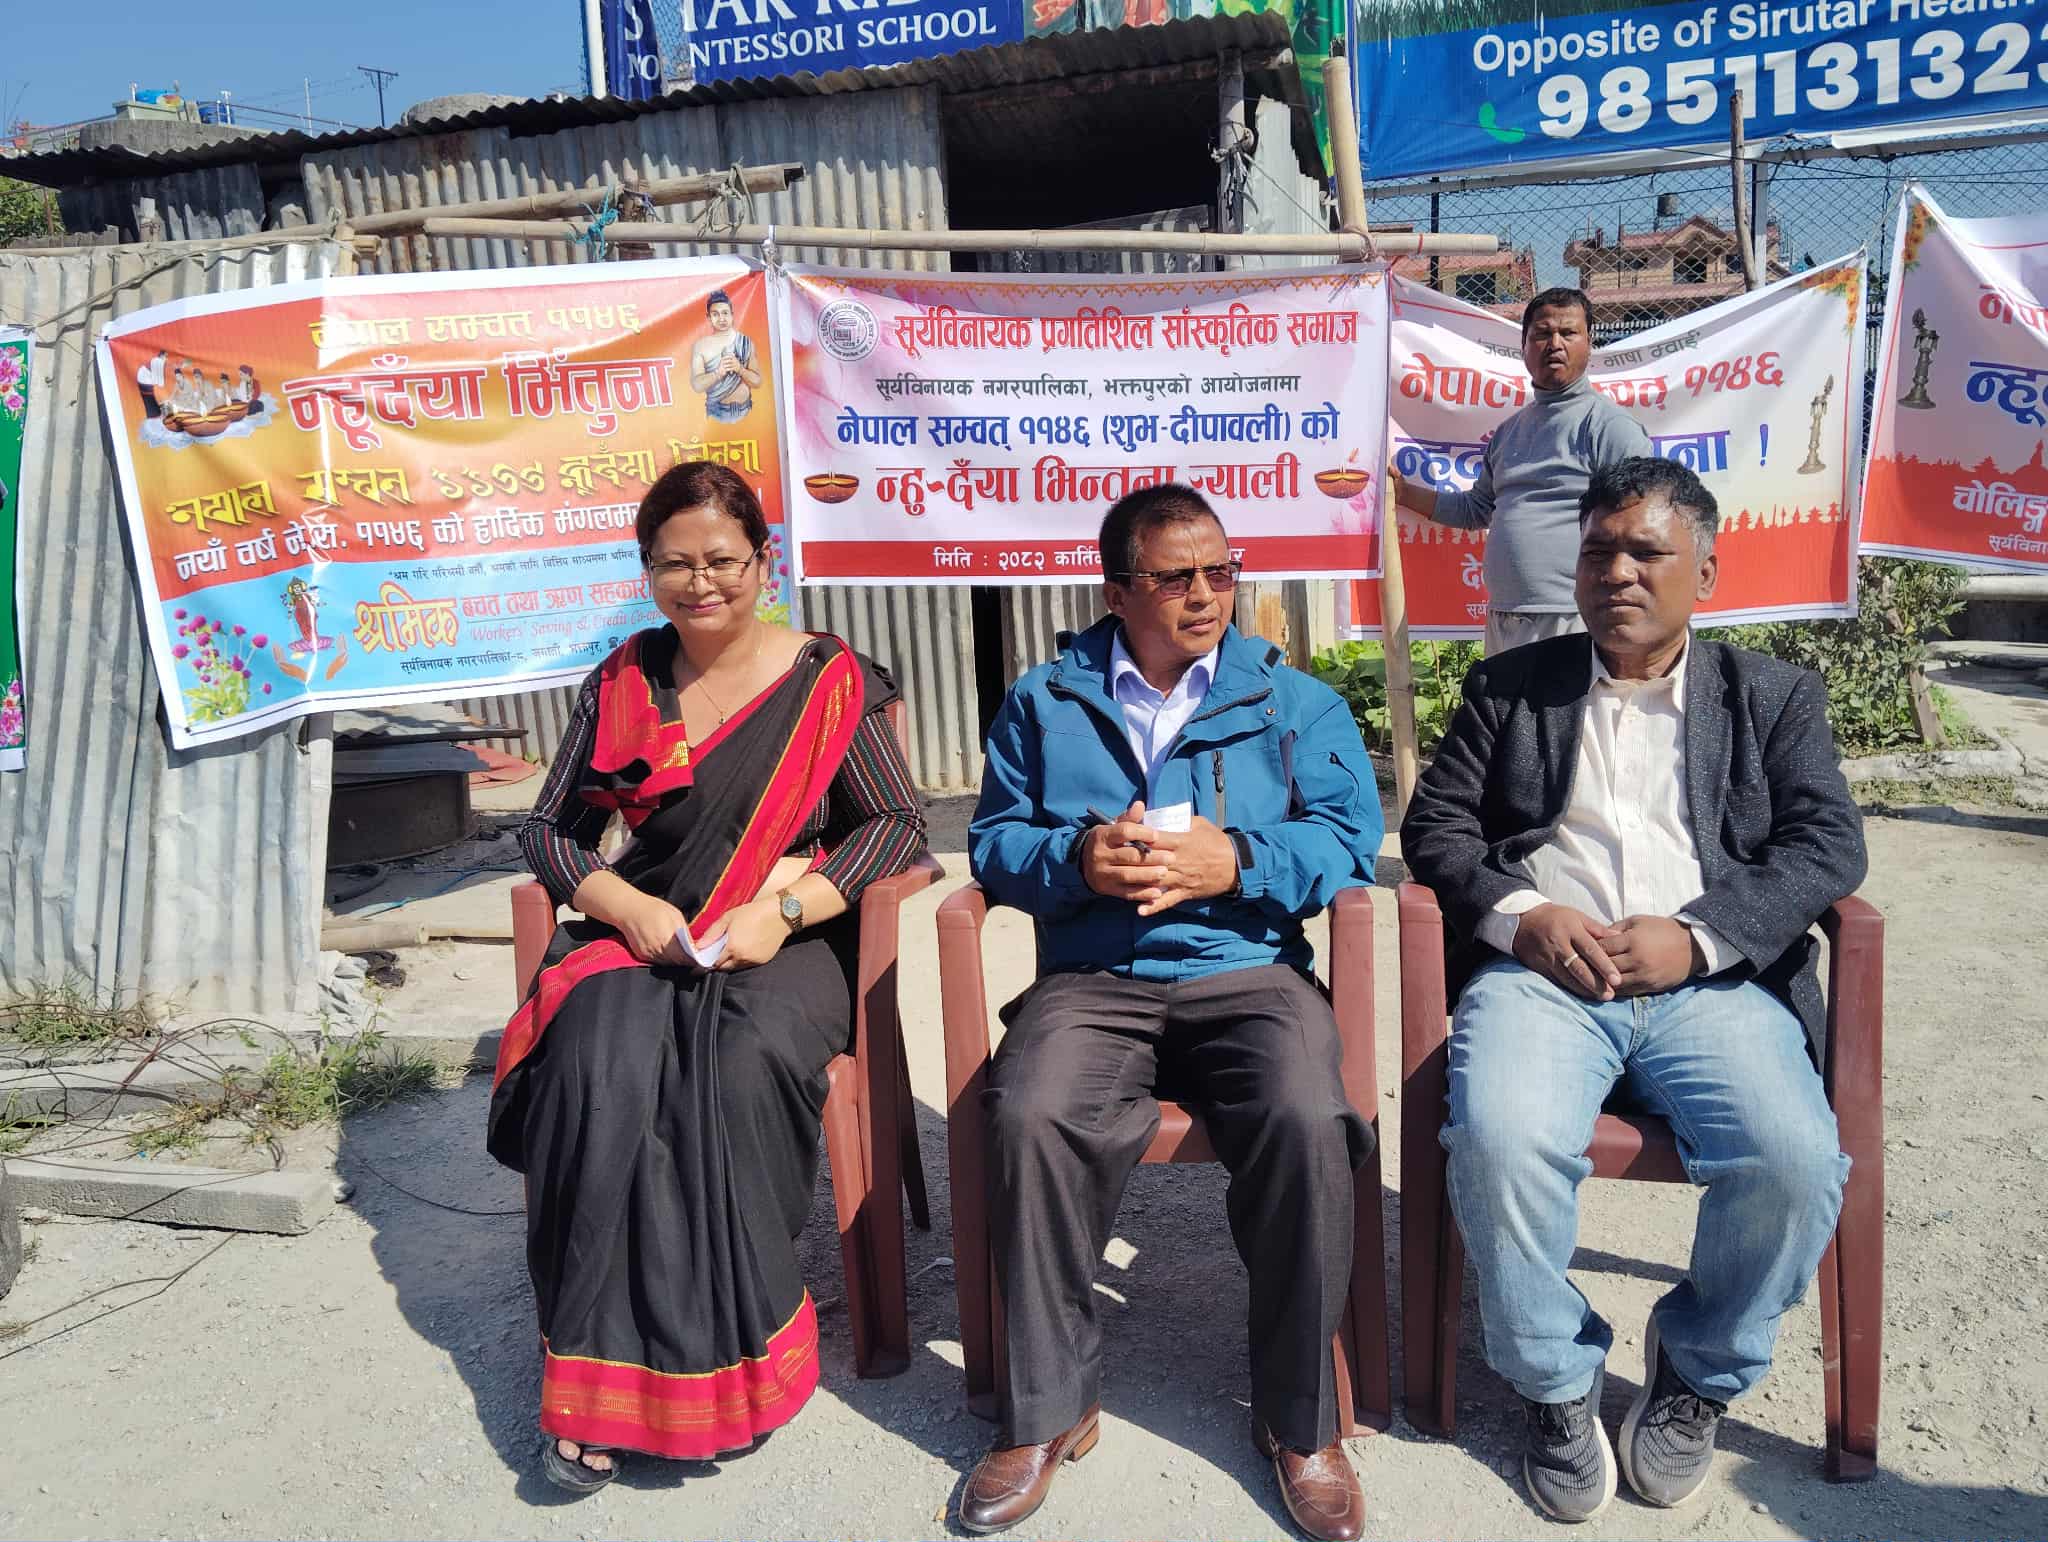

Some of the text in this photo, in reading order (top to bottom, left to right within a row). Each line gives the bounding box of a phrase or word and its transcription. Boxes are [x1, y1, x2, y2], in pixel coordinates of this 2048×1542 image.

[857, 7, 997, 48] SCHOOL
[1473, 0, 2035, 77] Opposite of Sirutar Hea
[547, 303, 641, 334] ११४६
[894, 305, 1032, 359] सूर्यविनायक
[1039, 305, 1154, 352] प्रगतिशिल
[1162, 303, 1279, 357] सांस्कृतिक
[1287, 310, 1358, 347] समाज
[875, 372, 1301, 401] सूर्यविनायक नगरपालिका, भक्तपुरको आयोजनामा
[1400, 352, 1527, 408] नेपाल
[1684, 351, 1783, 397] ११४६
[837, 406, 919, 446] नेपाल
[928, 416, 1012, 451] सम्वत्
[1019, 416, 1090, 447] ११४६
[1301, 401, 1340, 440] को
[235, 527, 278, 566] वर्ष
[356, 519, 425, 551] ११४६
[432, 511, 464, 545] को
[473, 506, 545, 545] हार्दिक
[933, 546, 973, 568] मिति
[998, 551, 1045, 571] २०८२
[1989, 534, 2048, 555] सूर्यविना
[353, 580, 459, 654] श्रमिक
[504, 591, 540, 614] तथा
